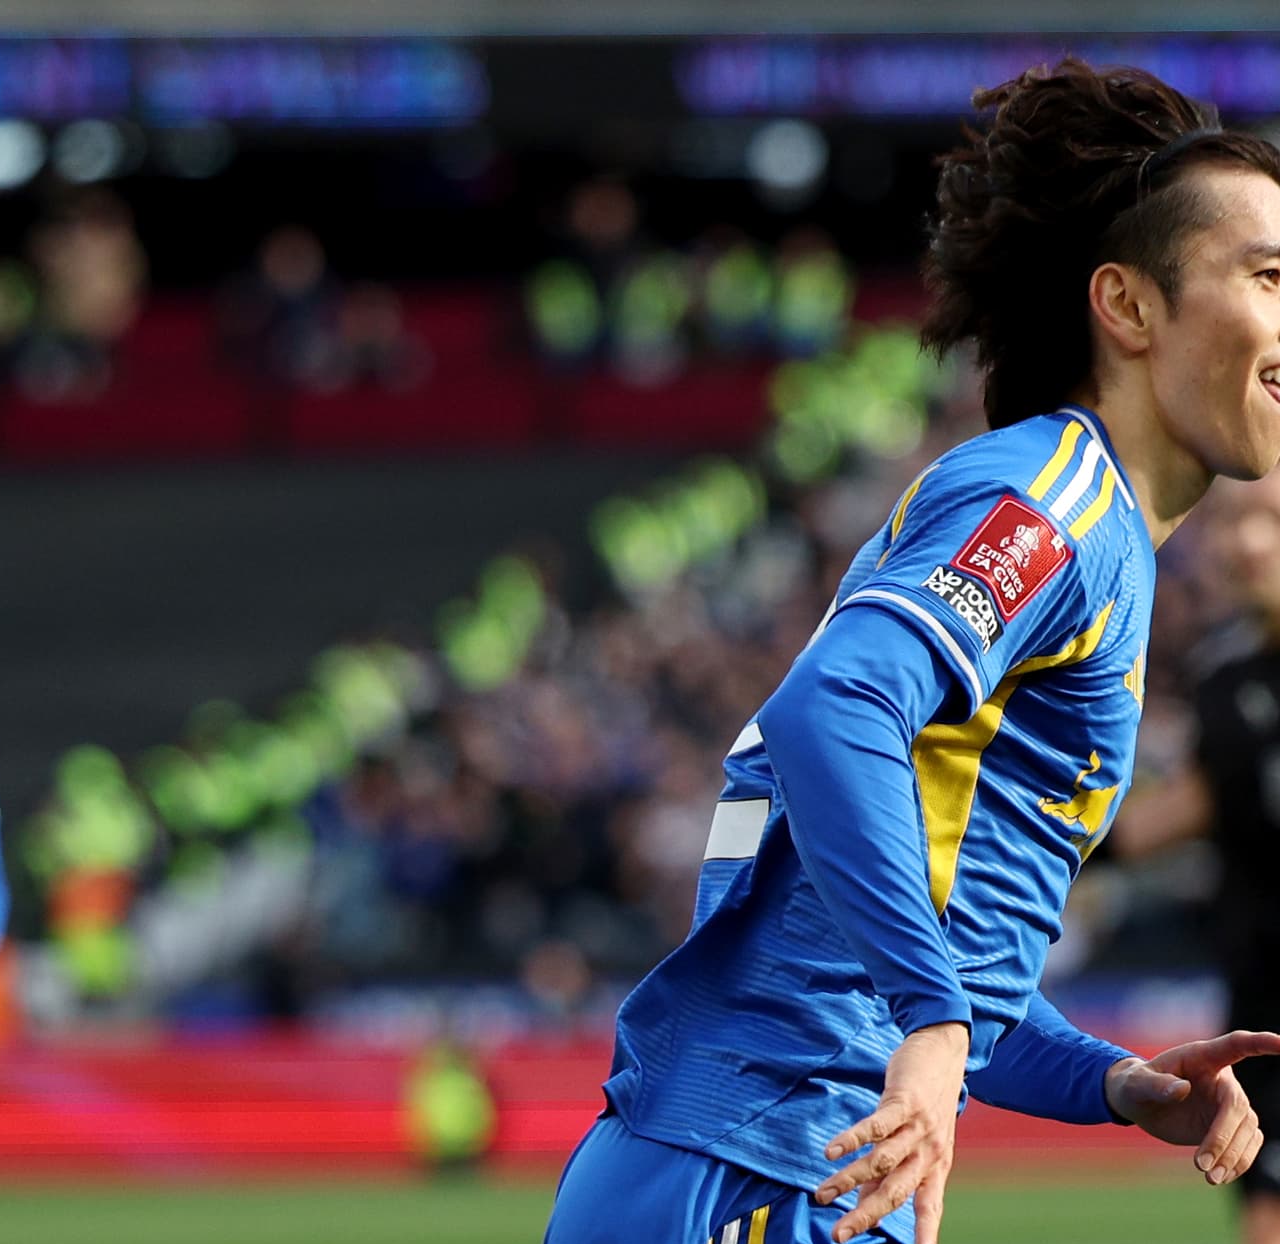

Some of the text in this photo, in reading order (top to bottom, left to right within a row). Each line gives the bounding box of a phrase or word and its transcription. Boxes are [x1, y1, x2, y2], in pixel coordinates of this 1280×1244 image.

[969, 553, 1017, 600] FA CUP
[977, 543, 1024, 593] Emirates
[927, 566, 997, 634] No room
[949, 594, 991, 655] racism
